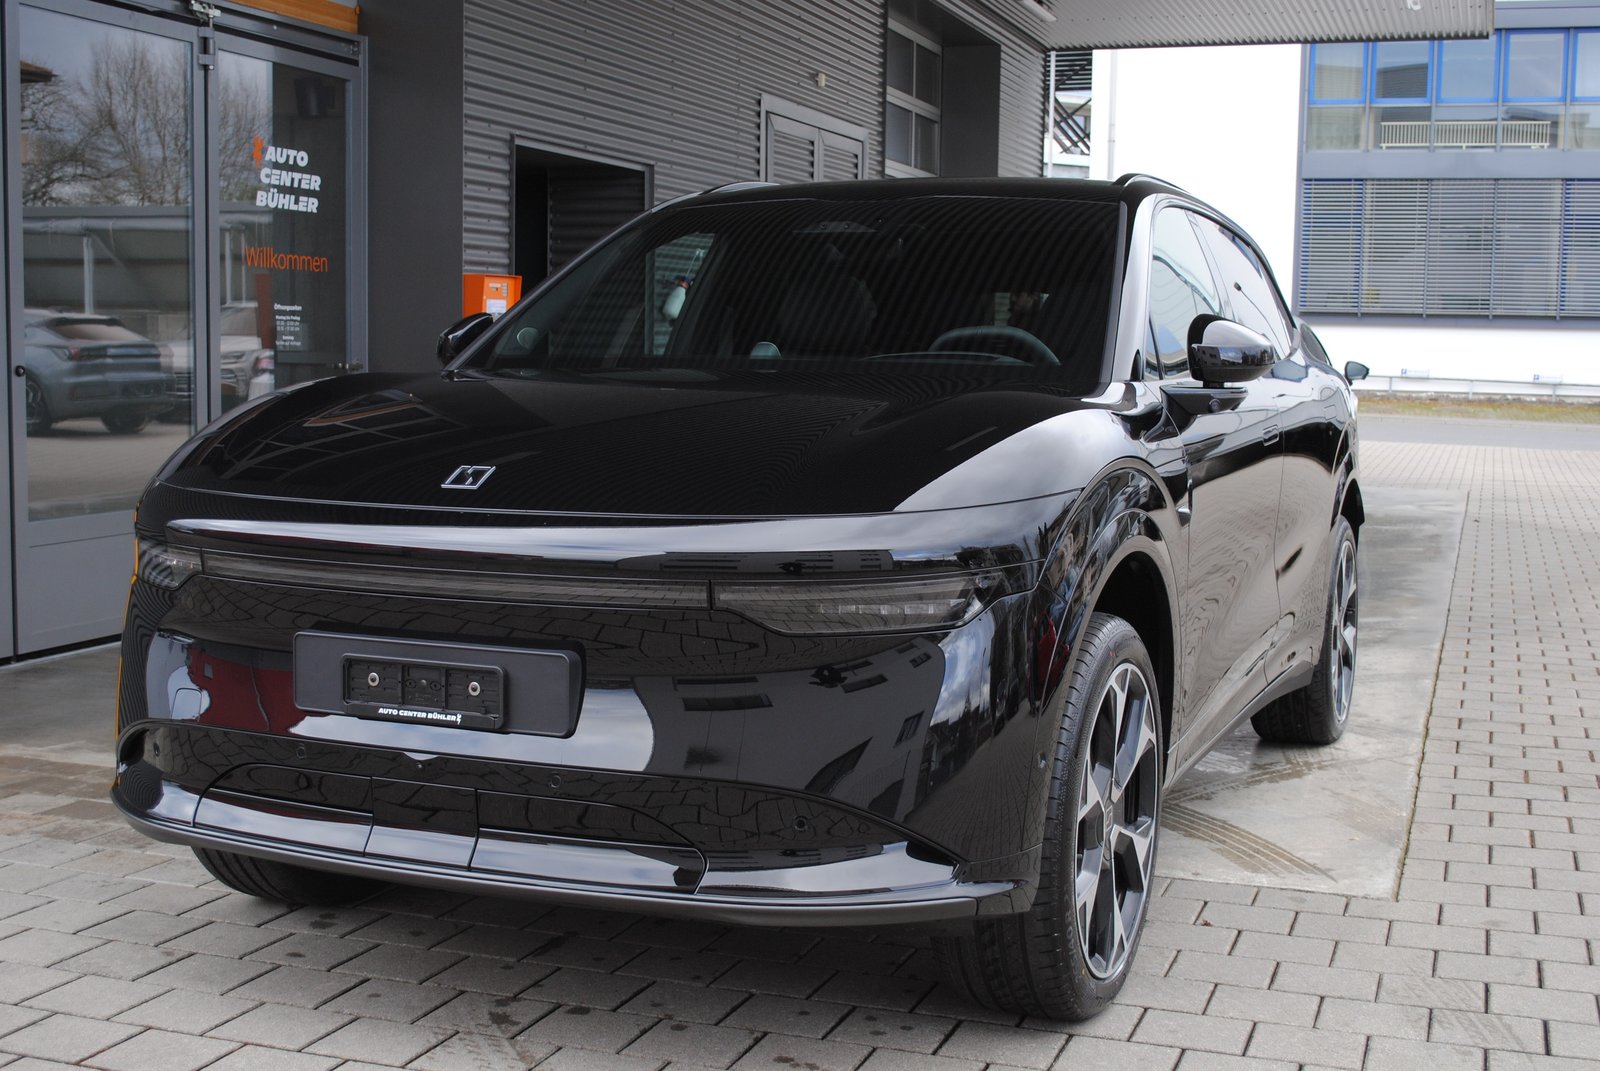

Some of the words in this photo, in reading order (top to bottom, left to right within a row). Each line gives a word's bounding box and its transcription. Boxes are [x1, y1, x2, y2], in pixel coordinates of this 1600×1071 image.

[265, 146, 309, 167] AUTO
[260, 169, 321, 191] CENTER
[256, 188, 318, 213] BÜHLER
[245, 246, 328, 272] Willkommen
[378, 707, 398, 715] AUTO
[399, 710, 427, 718] CENTER
[428, 713, 457, 721] BÜHLER
